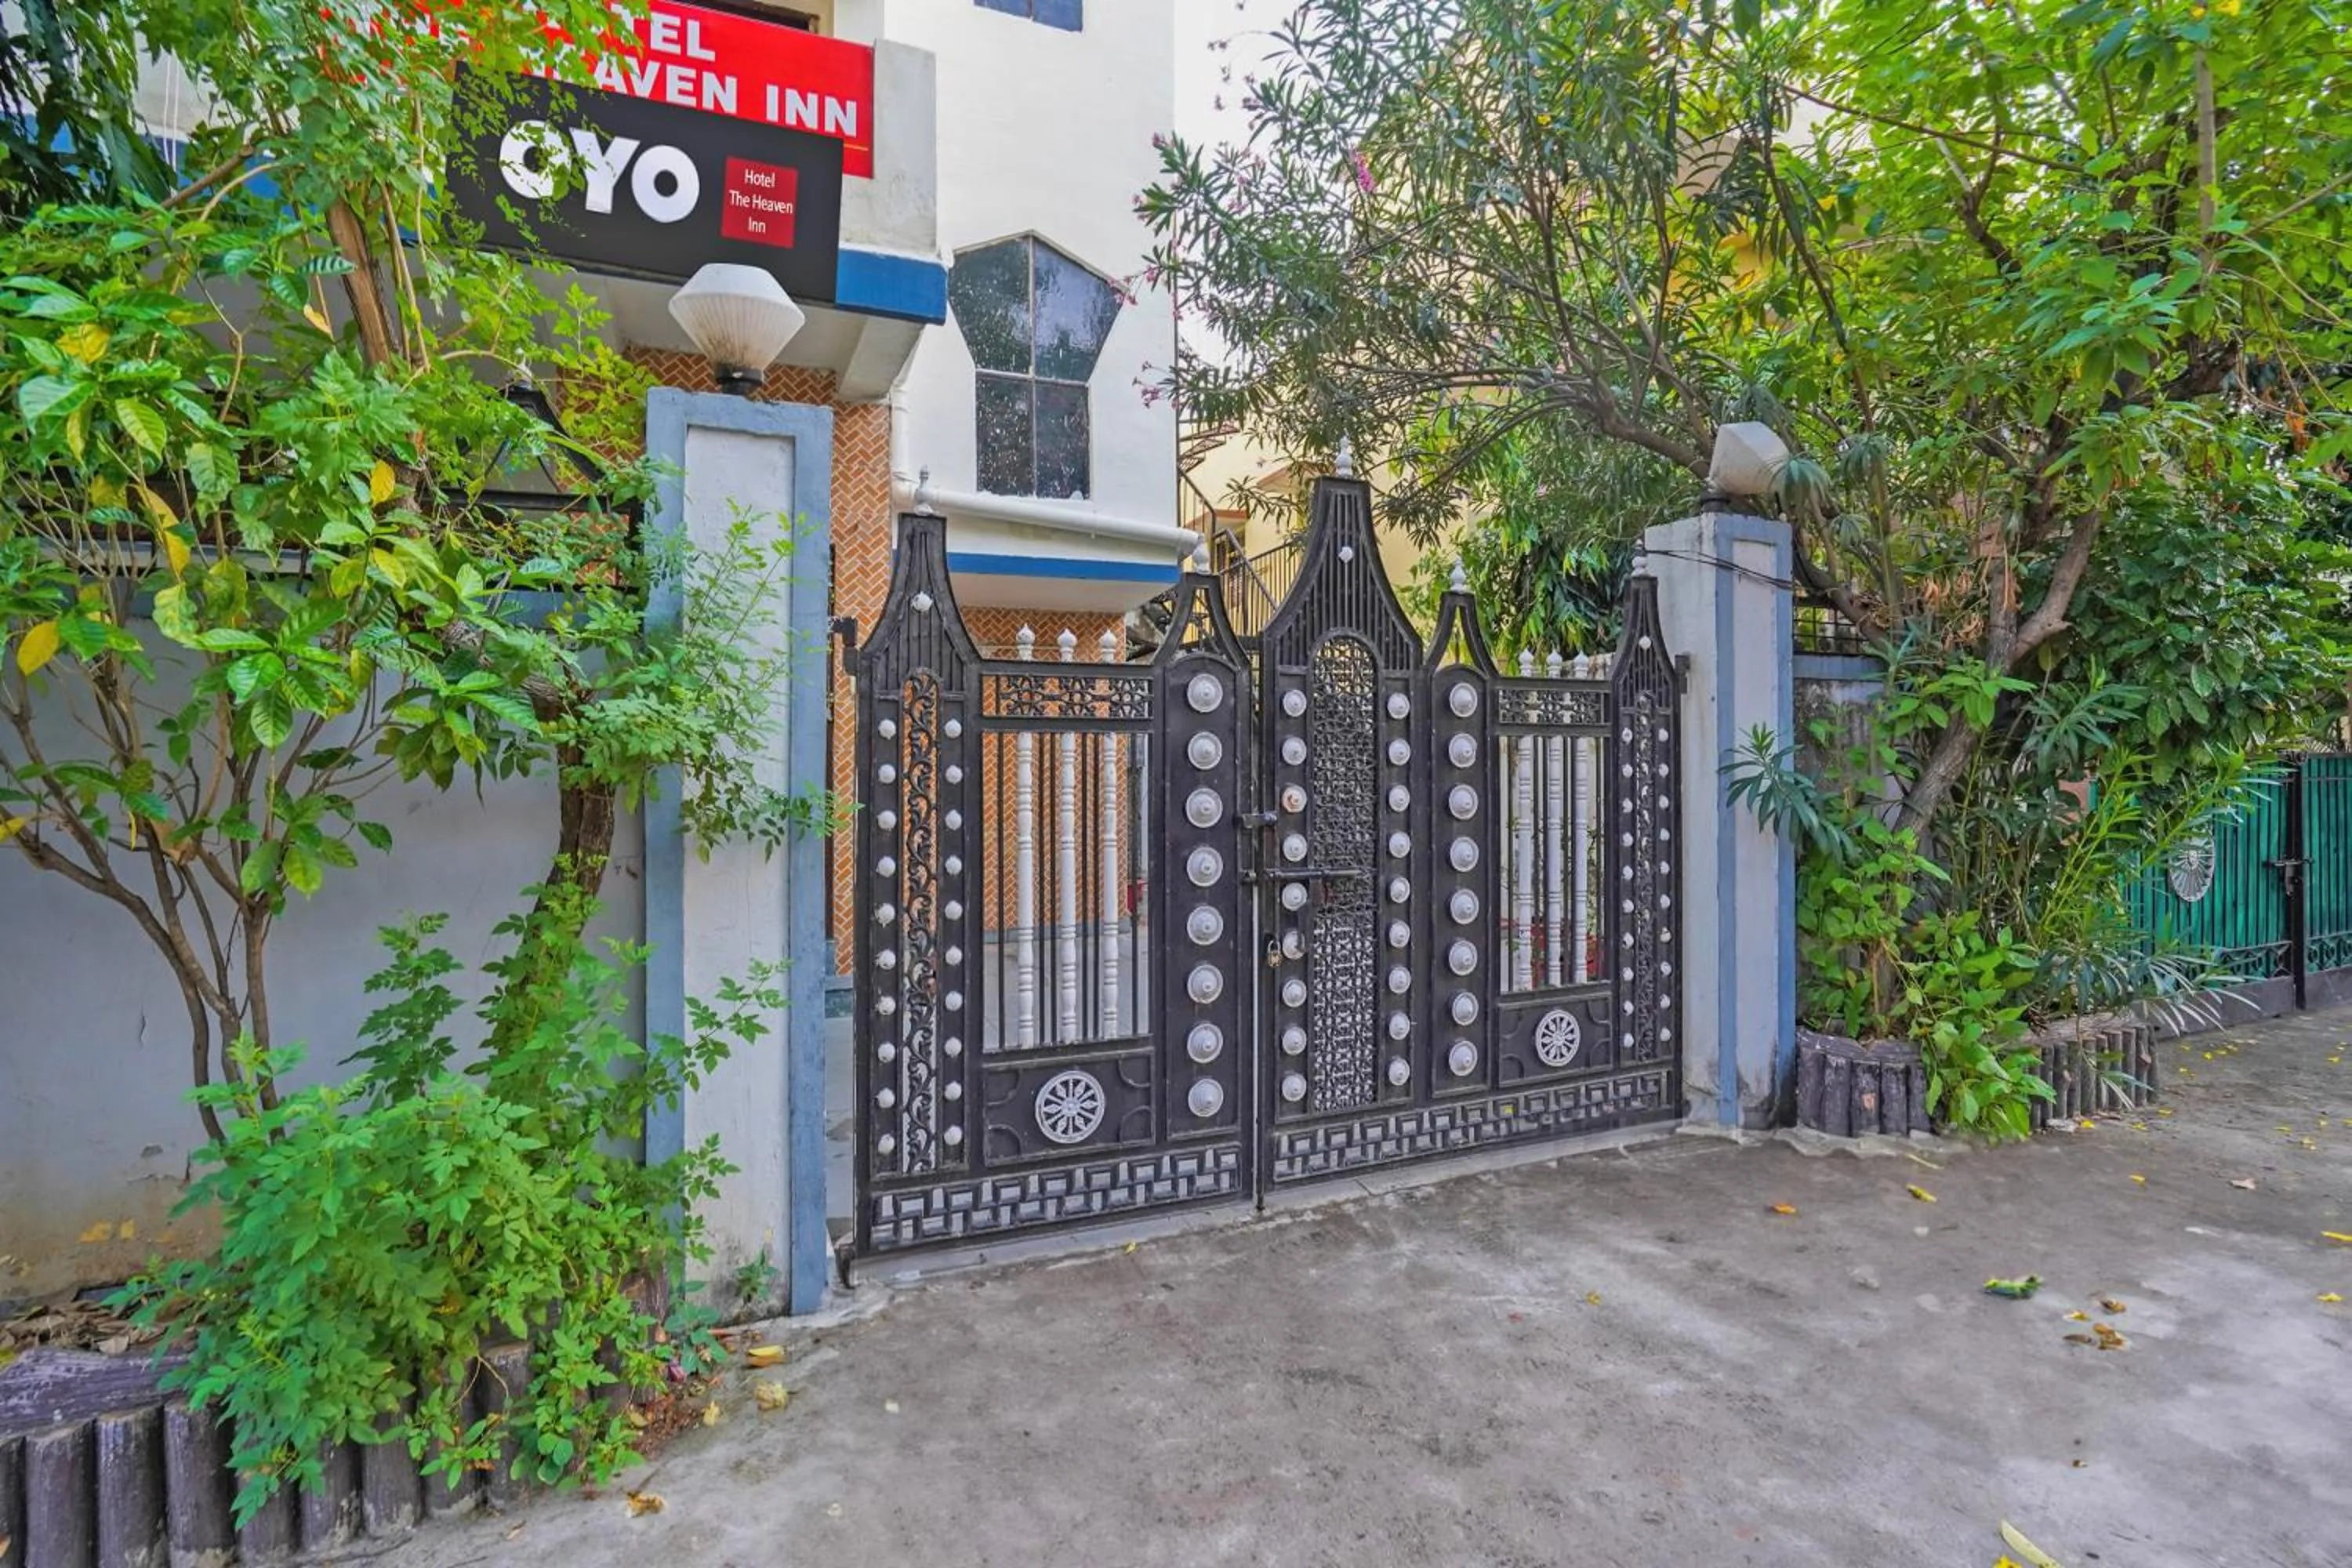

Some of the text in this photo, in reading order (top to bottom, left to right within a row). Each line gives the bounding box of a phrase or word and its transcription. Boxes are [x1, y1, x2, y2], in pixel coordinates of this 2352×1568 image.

[766, 83, 857, 138] INN
[499, 120, 700, 223] OYO
[744, 169, 775, 188] Hotel
[728, 189, 793, 214] The Heaven
[748, 216, 766, 234] Inn
